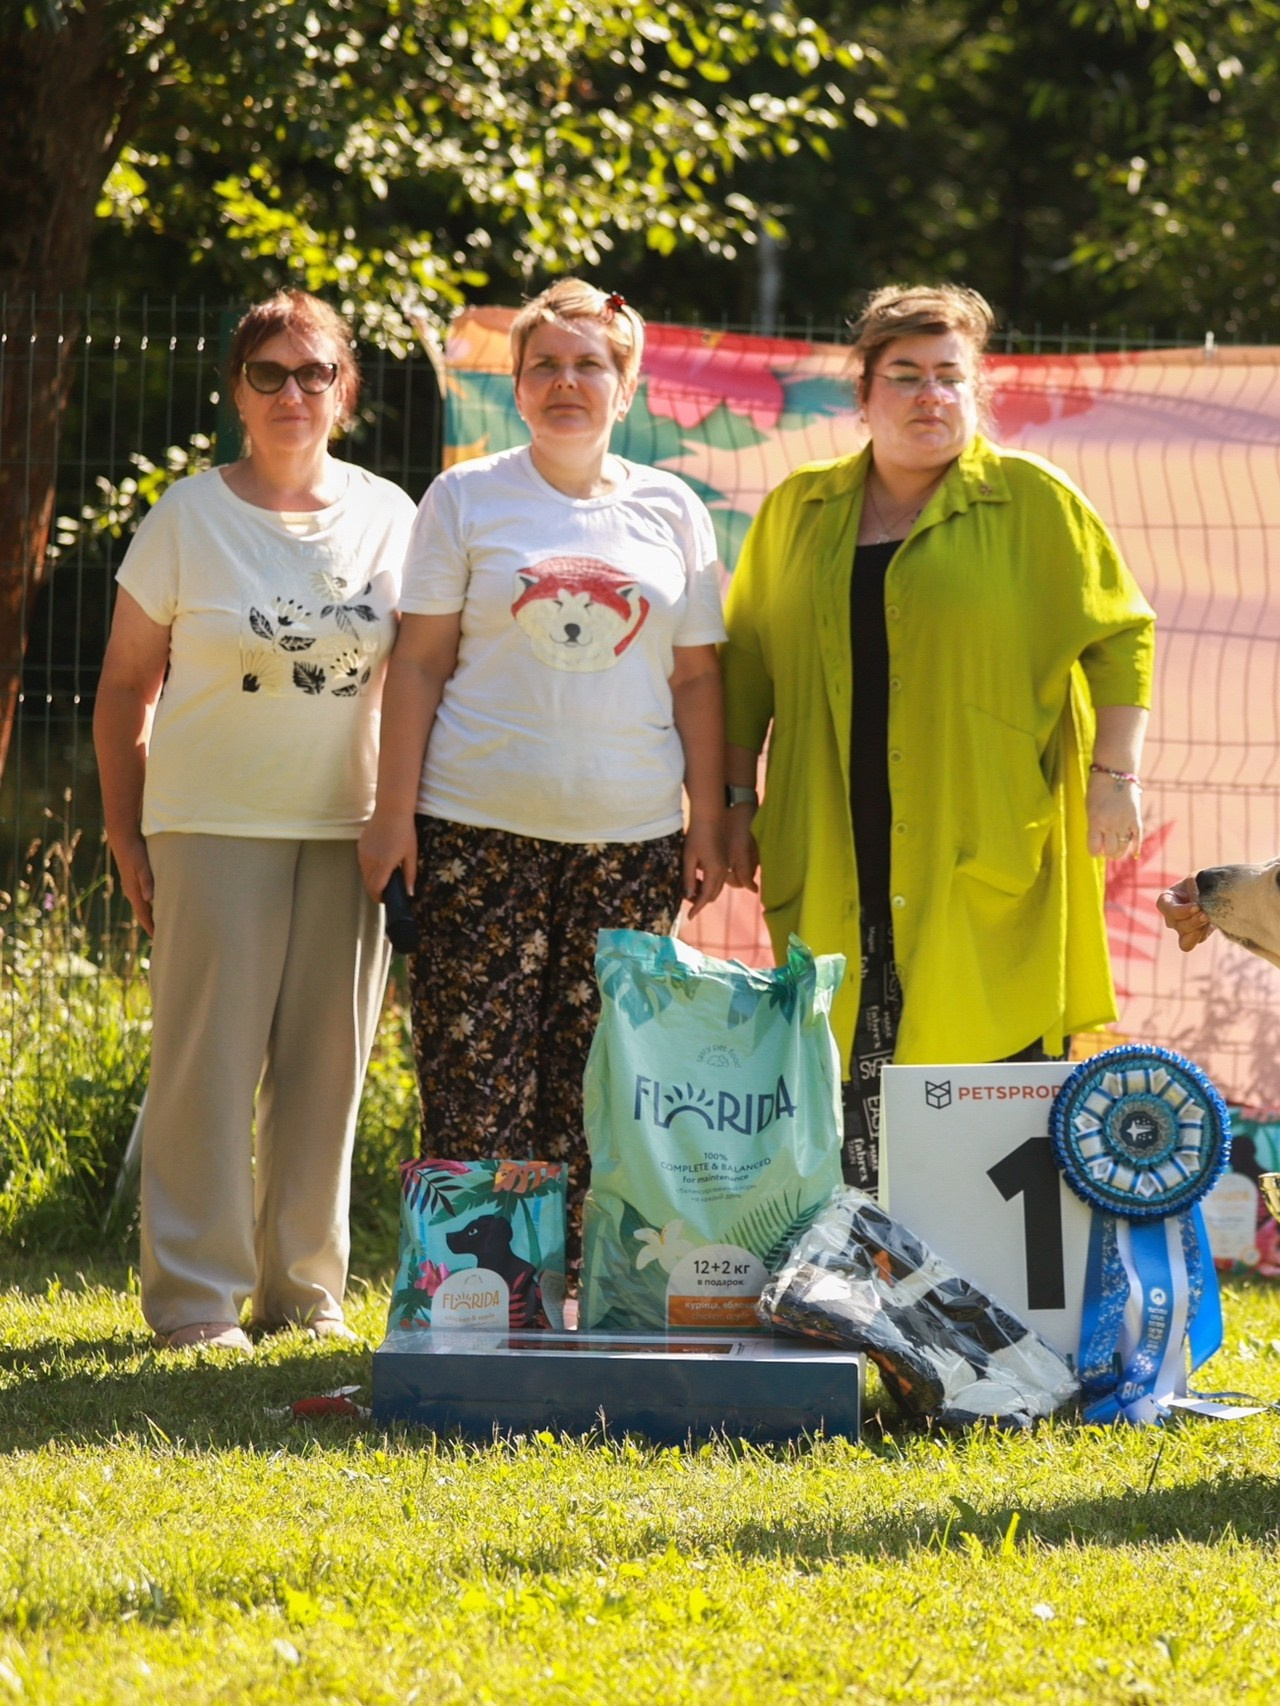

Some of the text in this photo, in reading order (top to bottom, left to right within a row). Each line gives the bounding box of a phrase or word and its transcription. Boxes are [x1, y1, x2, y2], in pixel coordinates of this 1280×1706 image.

[634, 1074, 797, 1136] FLORIDA
[704, 1152, 728, 1162] 100%
[660, 1157, 771, 1173] COMPLETE & BALANCED
[683, 1173, 749, 1184] for maintenance
[986, 1137, 1066, 1310] 1
[694, 1260, 751, 1275] 12+2 кг
[705, 1280, 744, 1288] подарок
[442, 1290, 501, 1310] FLORIDA
